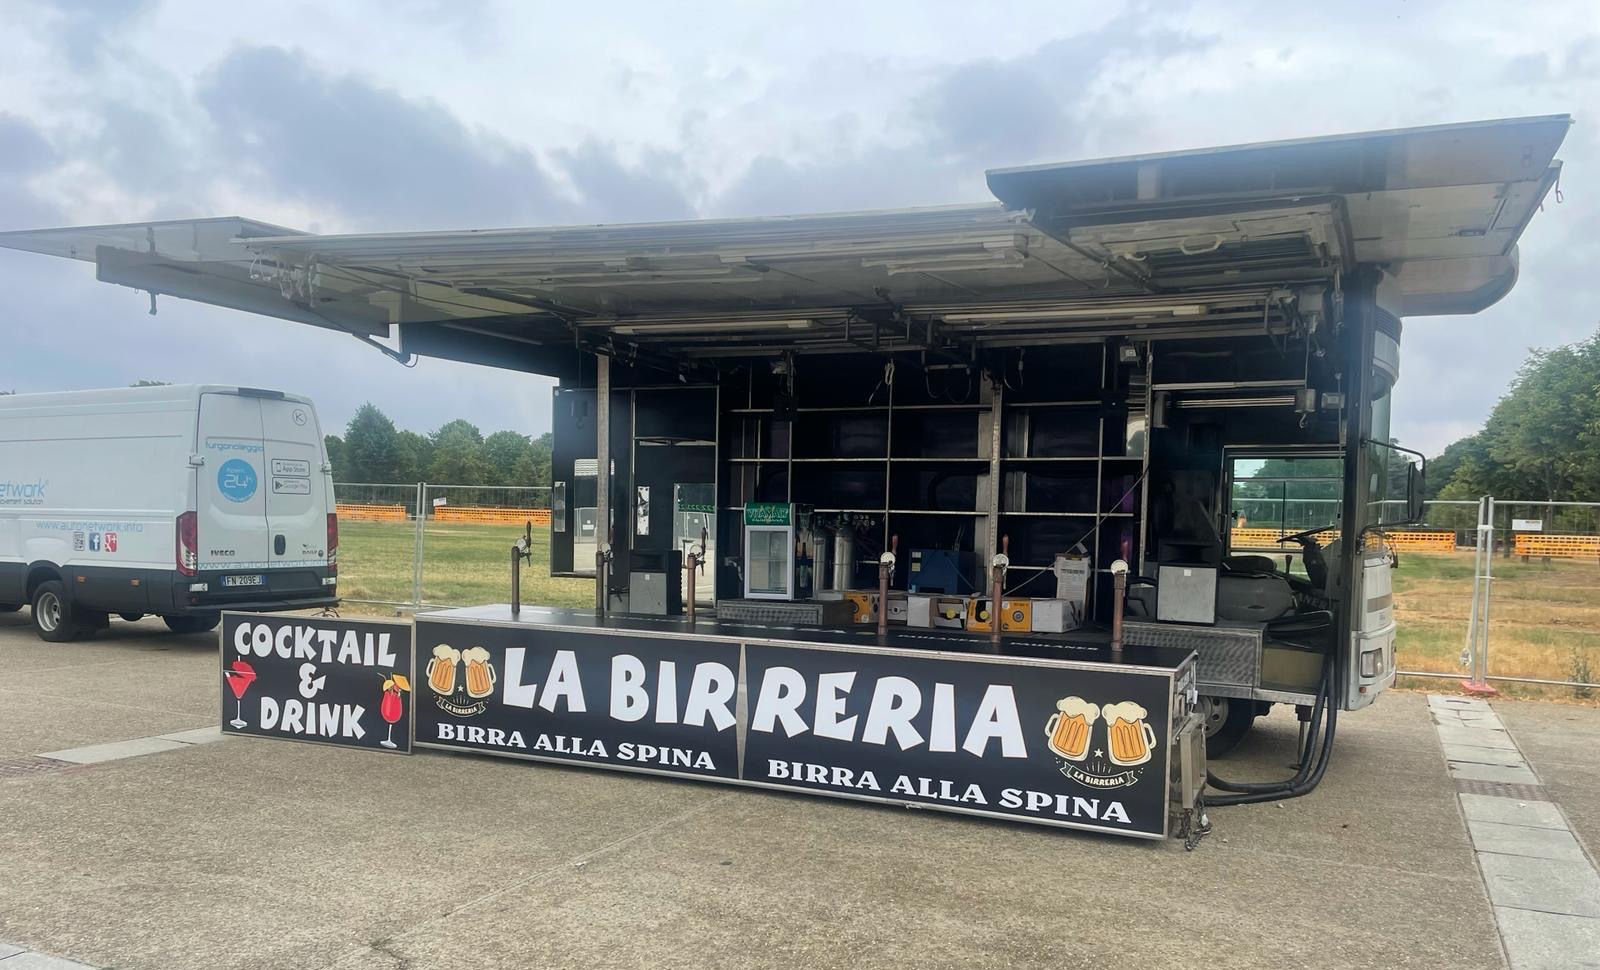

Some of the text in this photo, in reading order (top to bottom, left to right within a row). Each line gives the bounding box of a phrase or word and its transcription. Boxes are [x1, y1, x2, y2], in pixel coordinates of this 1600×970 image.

[226, 576, 237, 586] FN
[235, 623, 396, 667] COCKTAIL
[299, 663, 325, 698] &
[261, 697, 365, 739] DRINK
[445, 703, 478, 715] LA BIRRERIA
[503, 648, 1027, 758] LA BIRRERIA
[437, 723, 715, 770] BIRRA ALLA SPINA
[767, 759, 1132, 824] BIRRA ALLA SPINA
[1073, 771, 1125, 786] LA BIRRERIA
